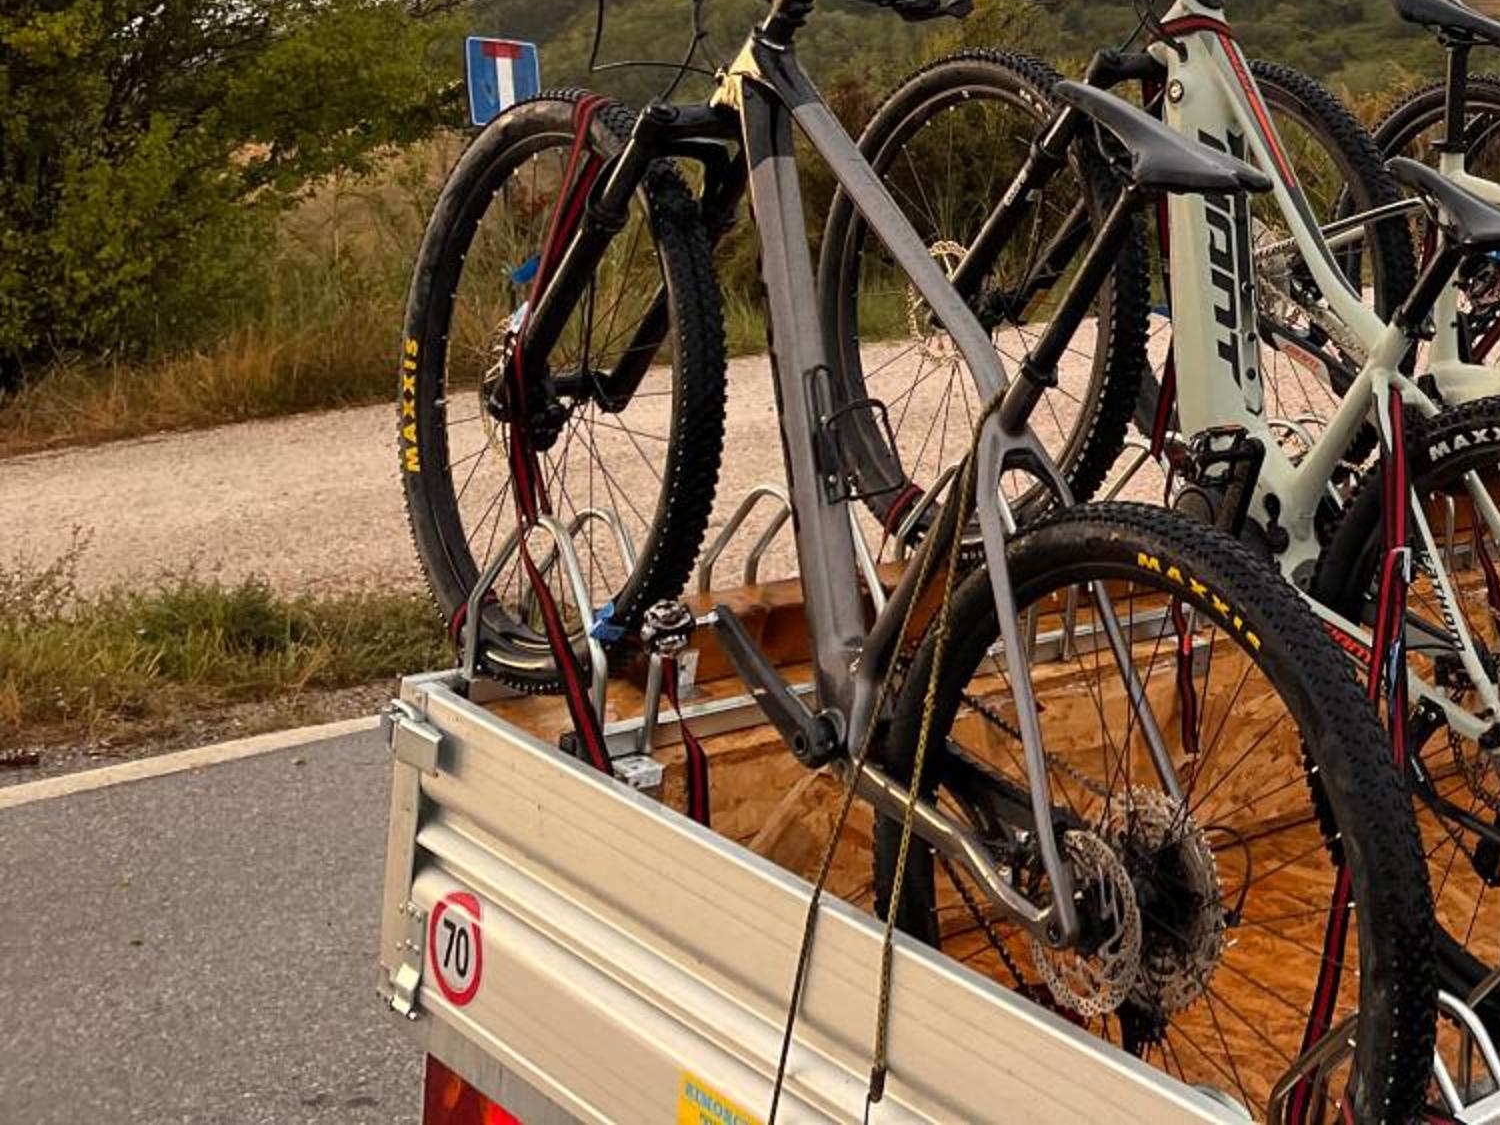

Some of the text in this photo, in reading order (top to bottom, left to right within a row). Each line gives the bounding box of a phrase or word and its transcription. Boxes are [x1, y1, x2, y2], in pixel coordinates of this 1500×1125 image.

[402, 338, 421, 472] MAXXIS
[1137, 551, 1262, 651] MAXXIS
[443, 916, 470, 979] 70
